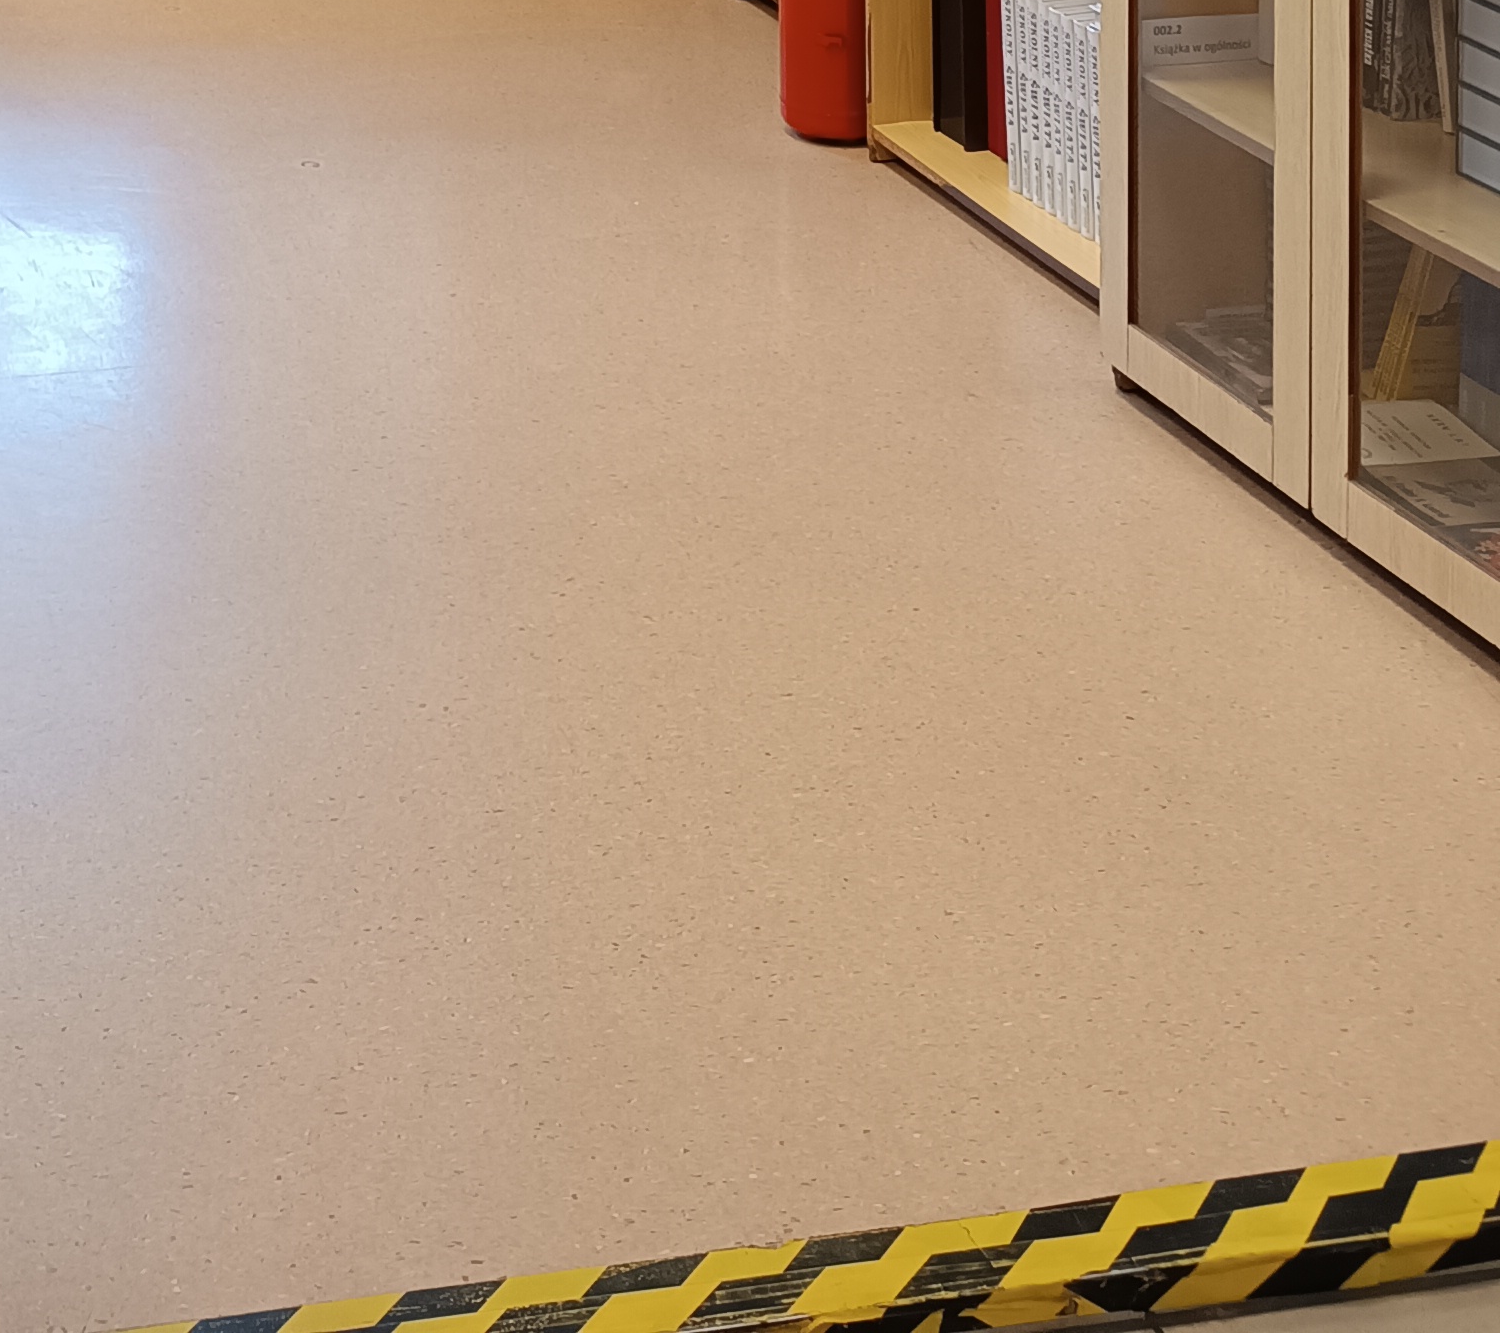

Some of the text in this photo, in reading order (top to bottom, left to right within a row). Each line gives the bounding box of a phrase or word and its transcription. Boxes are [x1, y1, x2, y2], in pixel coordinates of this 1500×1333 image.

[1153, 25, 1182, 36] 002.2
[1153, 39, 1252, 56] Książka w ogólności
